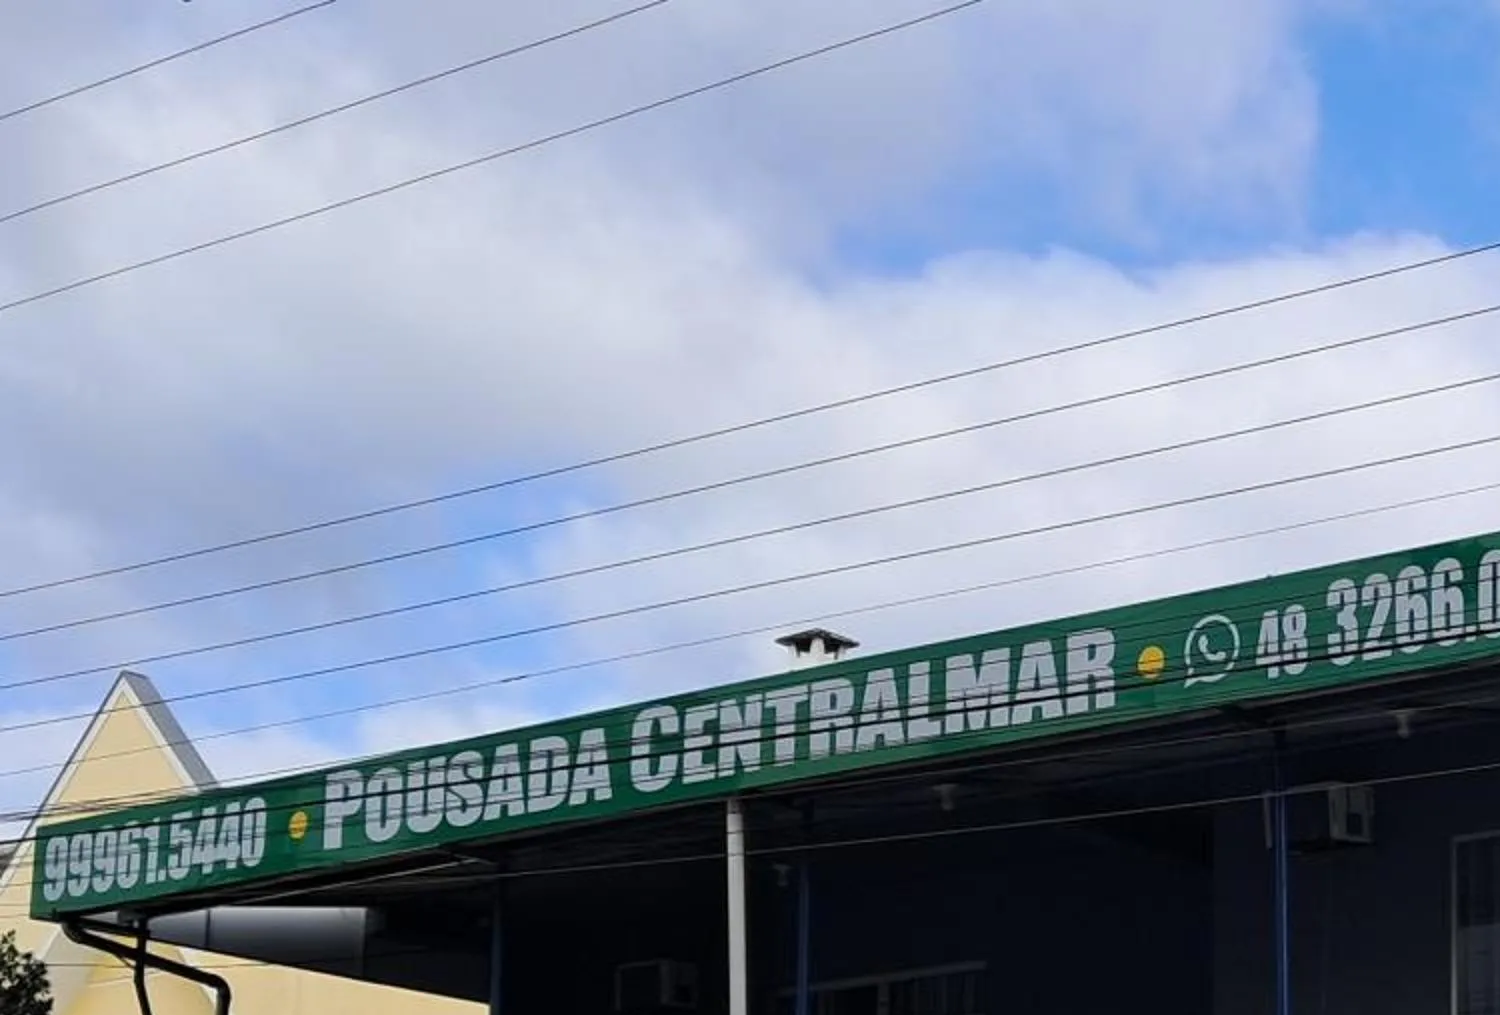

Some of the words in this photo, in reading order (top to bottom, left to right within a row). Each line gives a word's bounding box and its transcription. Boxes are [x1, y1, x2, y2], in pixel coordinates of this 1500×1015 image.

[43, 797, 267, 901] 99961.5440
[322, 727, 612, 849] POUSADA
[629, 627, 1117, 792] CENTRALMAR
[1255, 604, 1308, 680] 48
